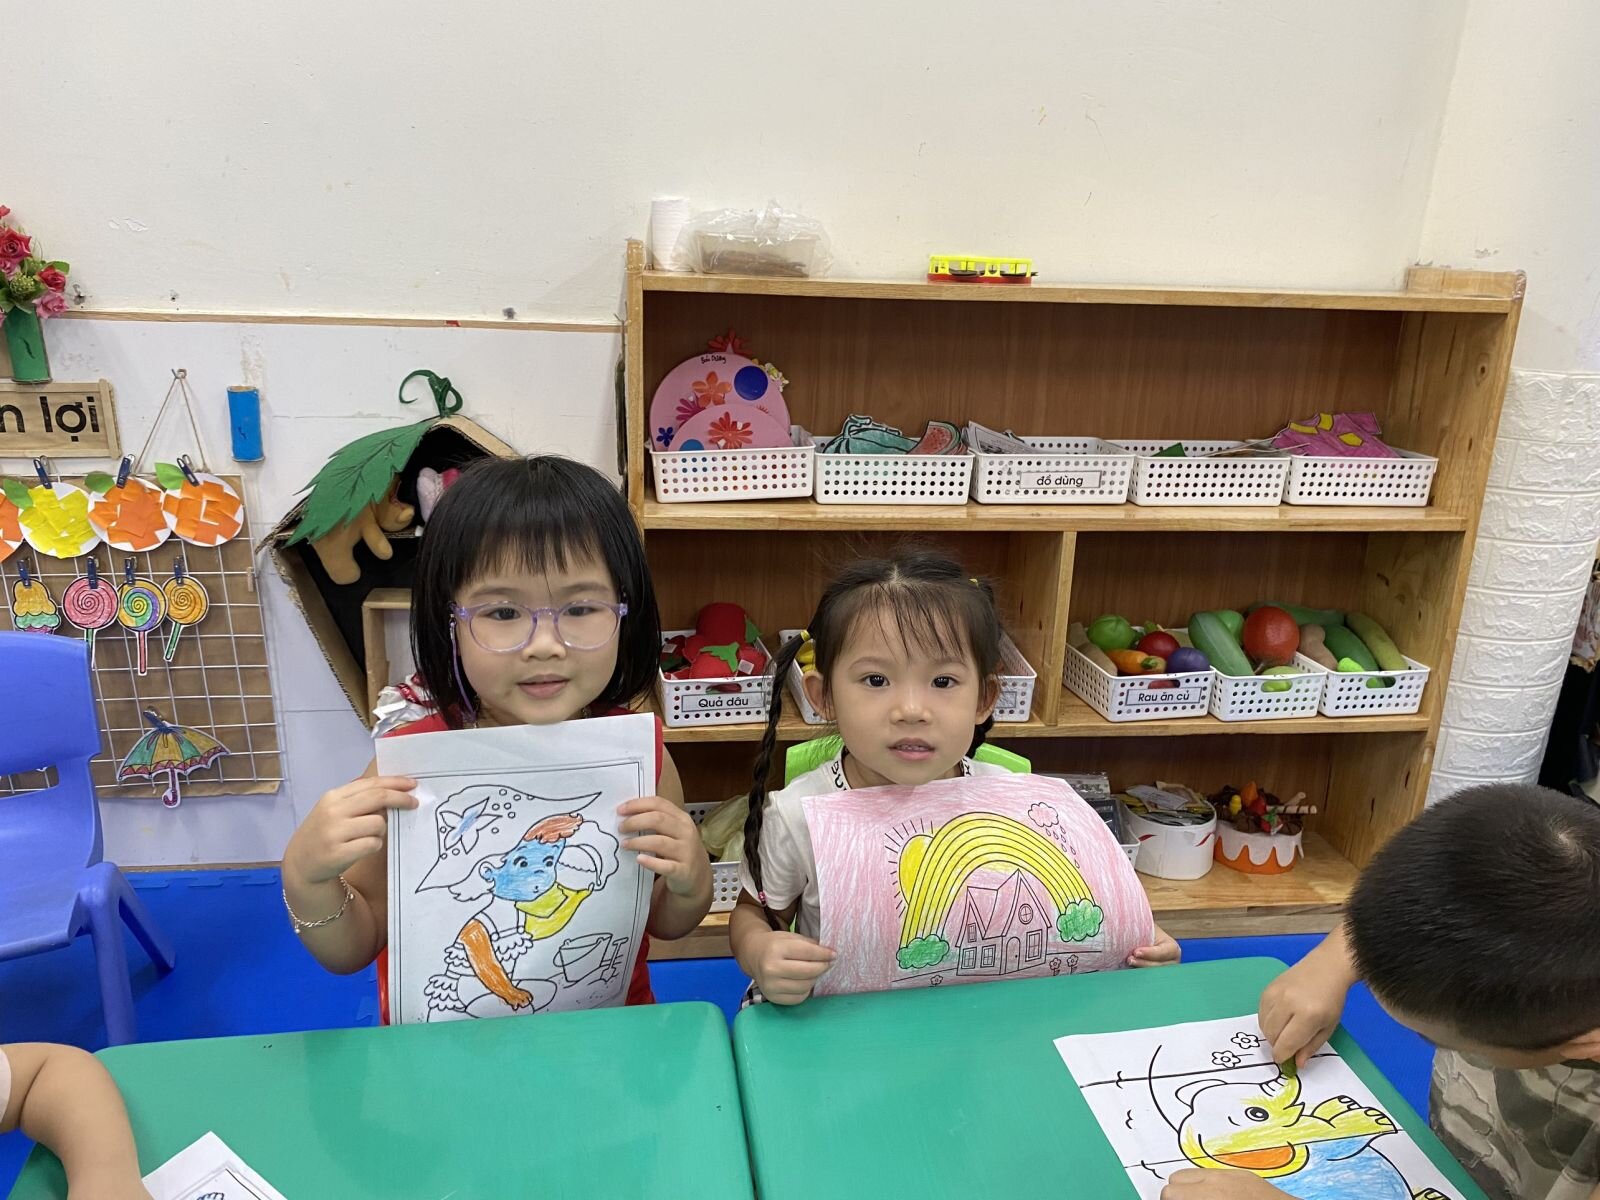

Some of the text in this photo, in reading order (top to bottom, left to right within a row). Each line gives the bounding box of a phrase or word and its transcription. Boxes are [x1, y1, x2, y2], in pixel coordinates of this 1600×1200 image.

[39, 396, 100, 442] lợi
[1054, 474, 1084, 488] dùng
[698, 695, 749, 708] Quả dâu
[1138, 689, 1190, 702] Rau ăn củ
